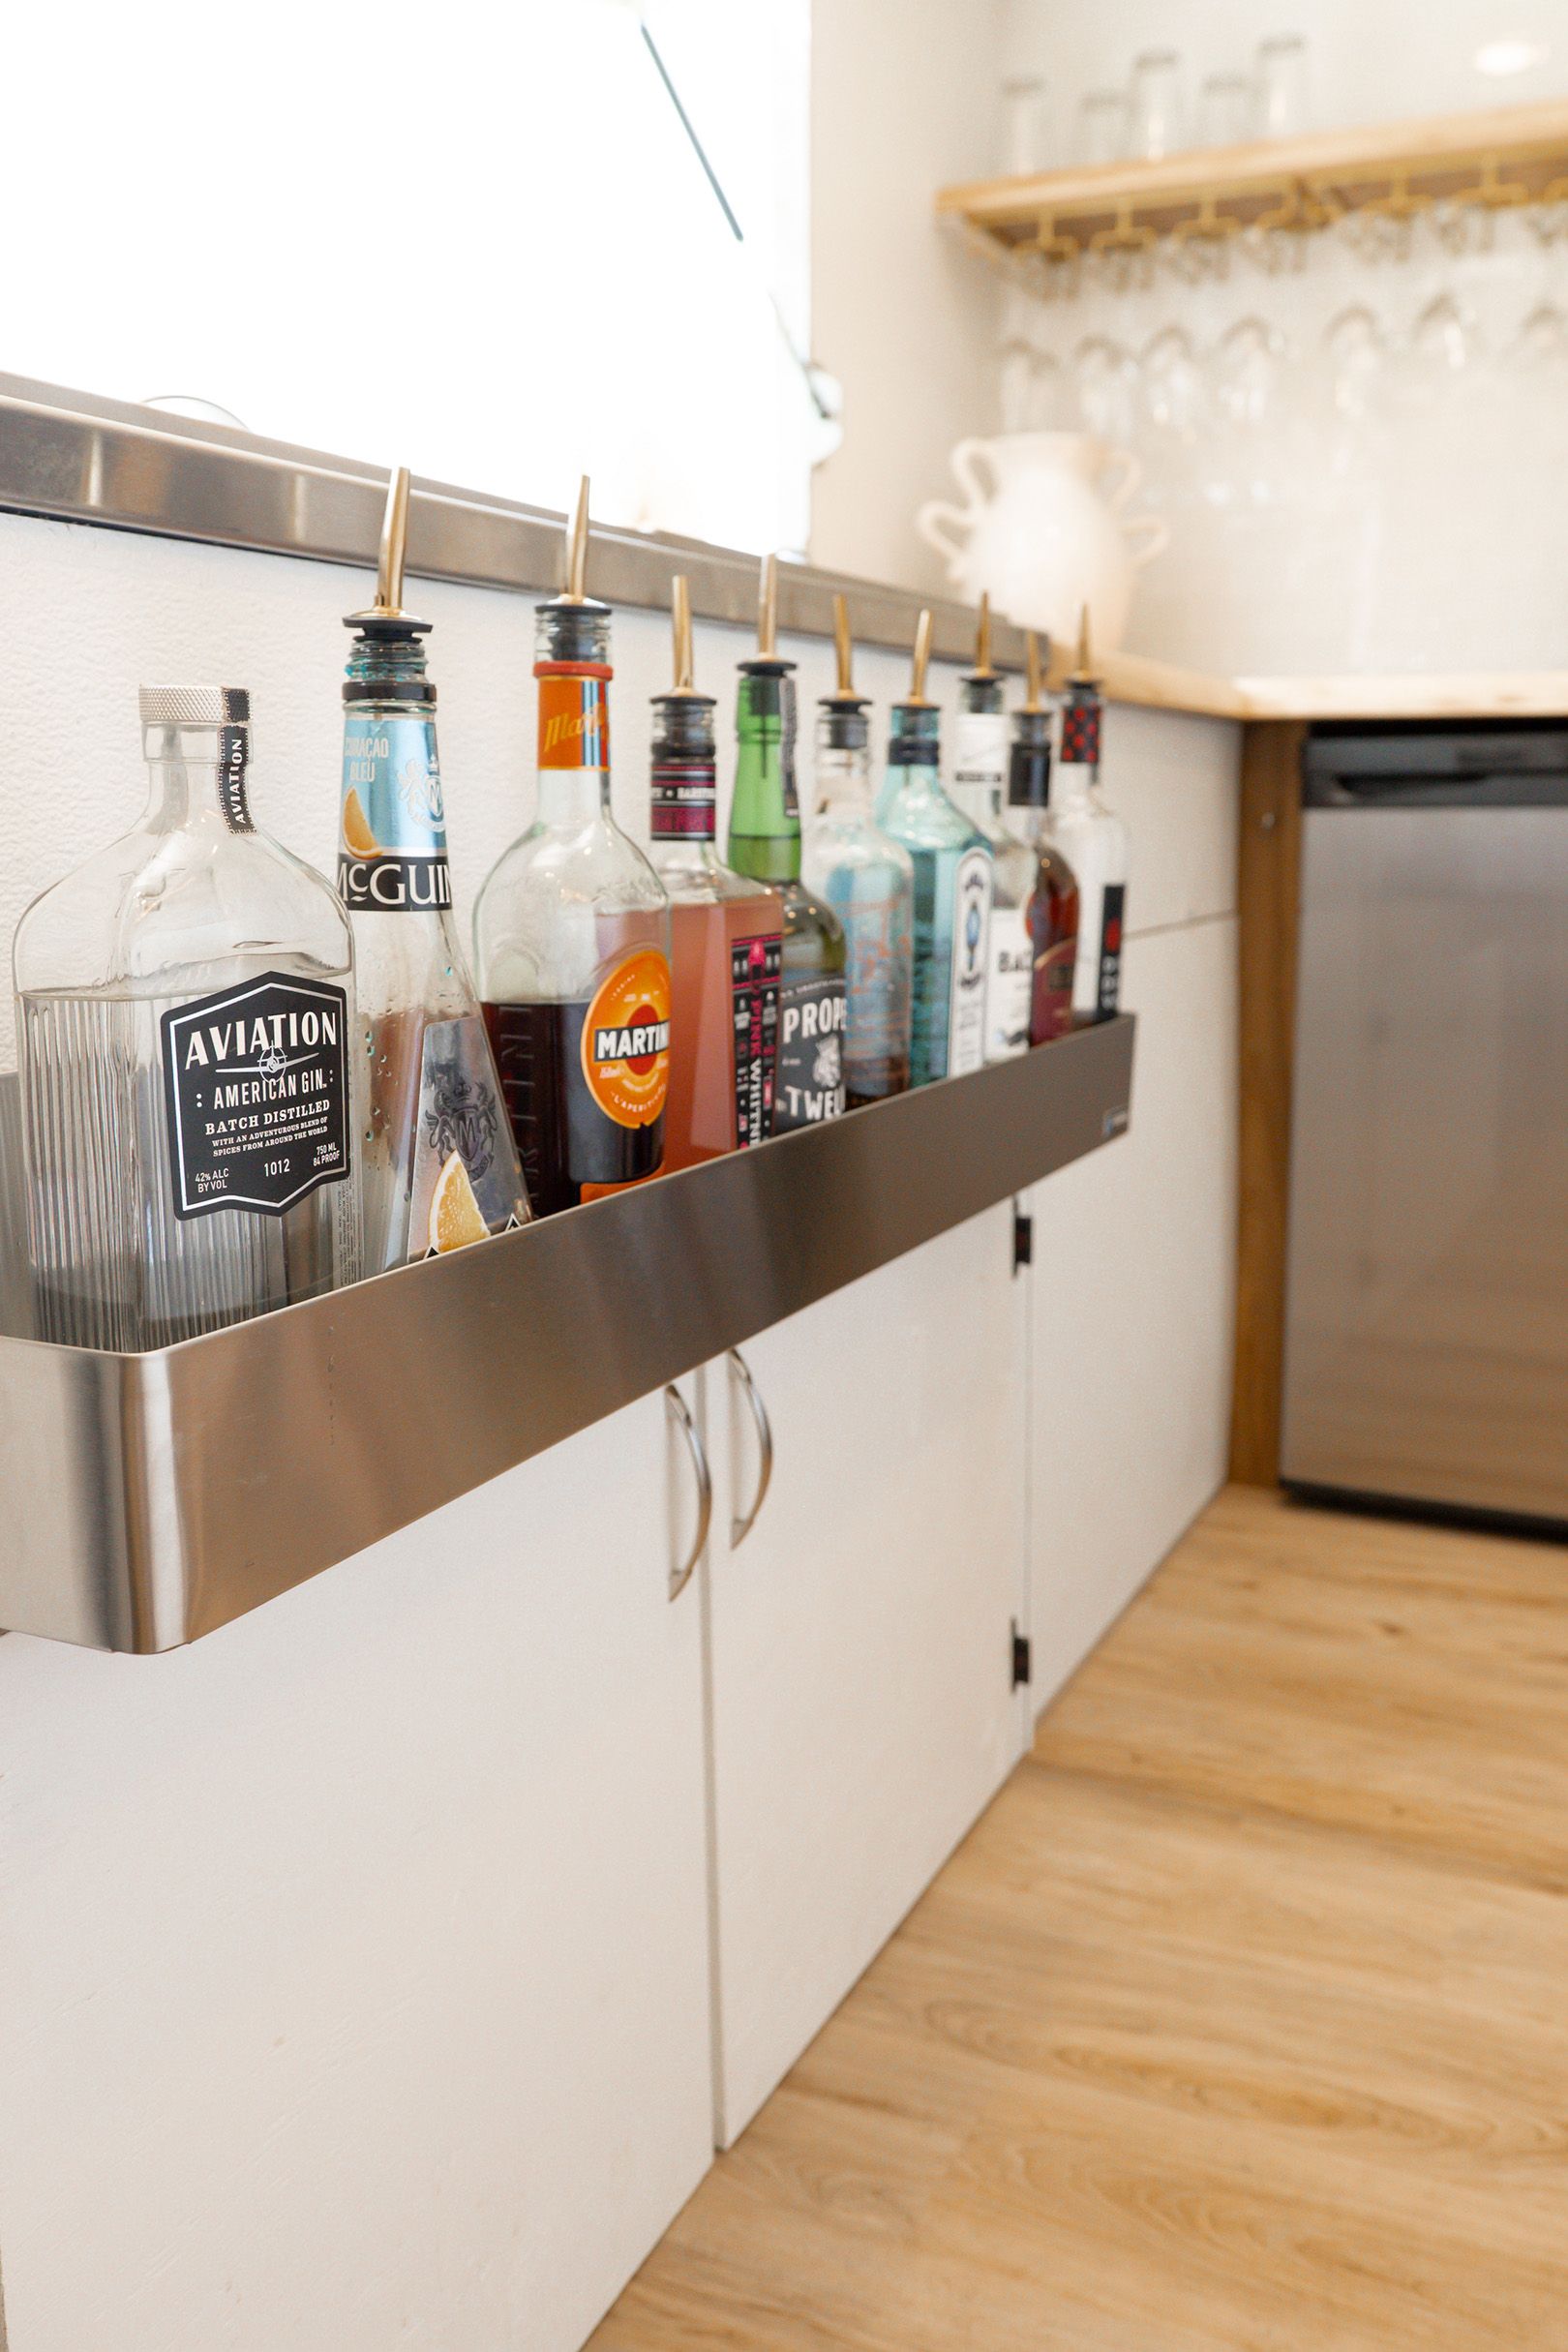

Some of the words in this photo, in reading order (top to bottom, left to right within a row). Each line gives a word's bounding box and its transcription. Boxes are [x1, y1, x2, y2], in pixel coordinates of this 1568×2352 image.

[229, 739, 246, 823] AVIATION
[185, 1011, 337, 1070] AVIATION
[214, 1073, 297, 1110] AMERICAN
[205, 1115, 259, 1135] BATCH
[263, 1100, 330, 1125] DISTILLED
[212, 1137, 234, 1147] WITH
[236, 1134, 247, 1143] AN
[249, 1124, 299, 1140] ADVENTUROUS
[300, 1118, 319, 1129] BLEND
[213, 1146, 241, 1157] SPICES
[243, 1142, 263, 1152] FROM
[264, 1134, 293, 1147] AROUND
[294, 1131, 307, 1140] THE
[308, 1126, 328, 1136] WORLD
[313, 1157, 320, 1167] 84
[321, 1151, 341, 1164] PROOF
[317, 1145, 327, 1156] 750
[328, 1142, 337, 1152] ML
[195, 1172, 211, 1183] 42%
[212, 1167, 229, 1180] ALC
[263, 1159, 290, 1177] 1012
[197, 1182, 209, 1193] BY
[210, 1179, 227, 1191] VOL
